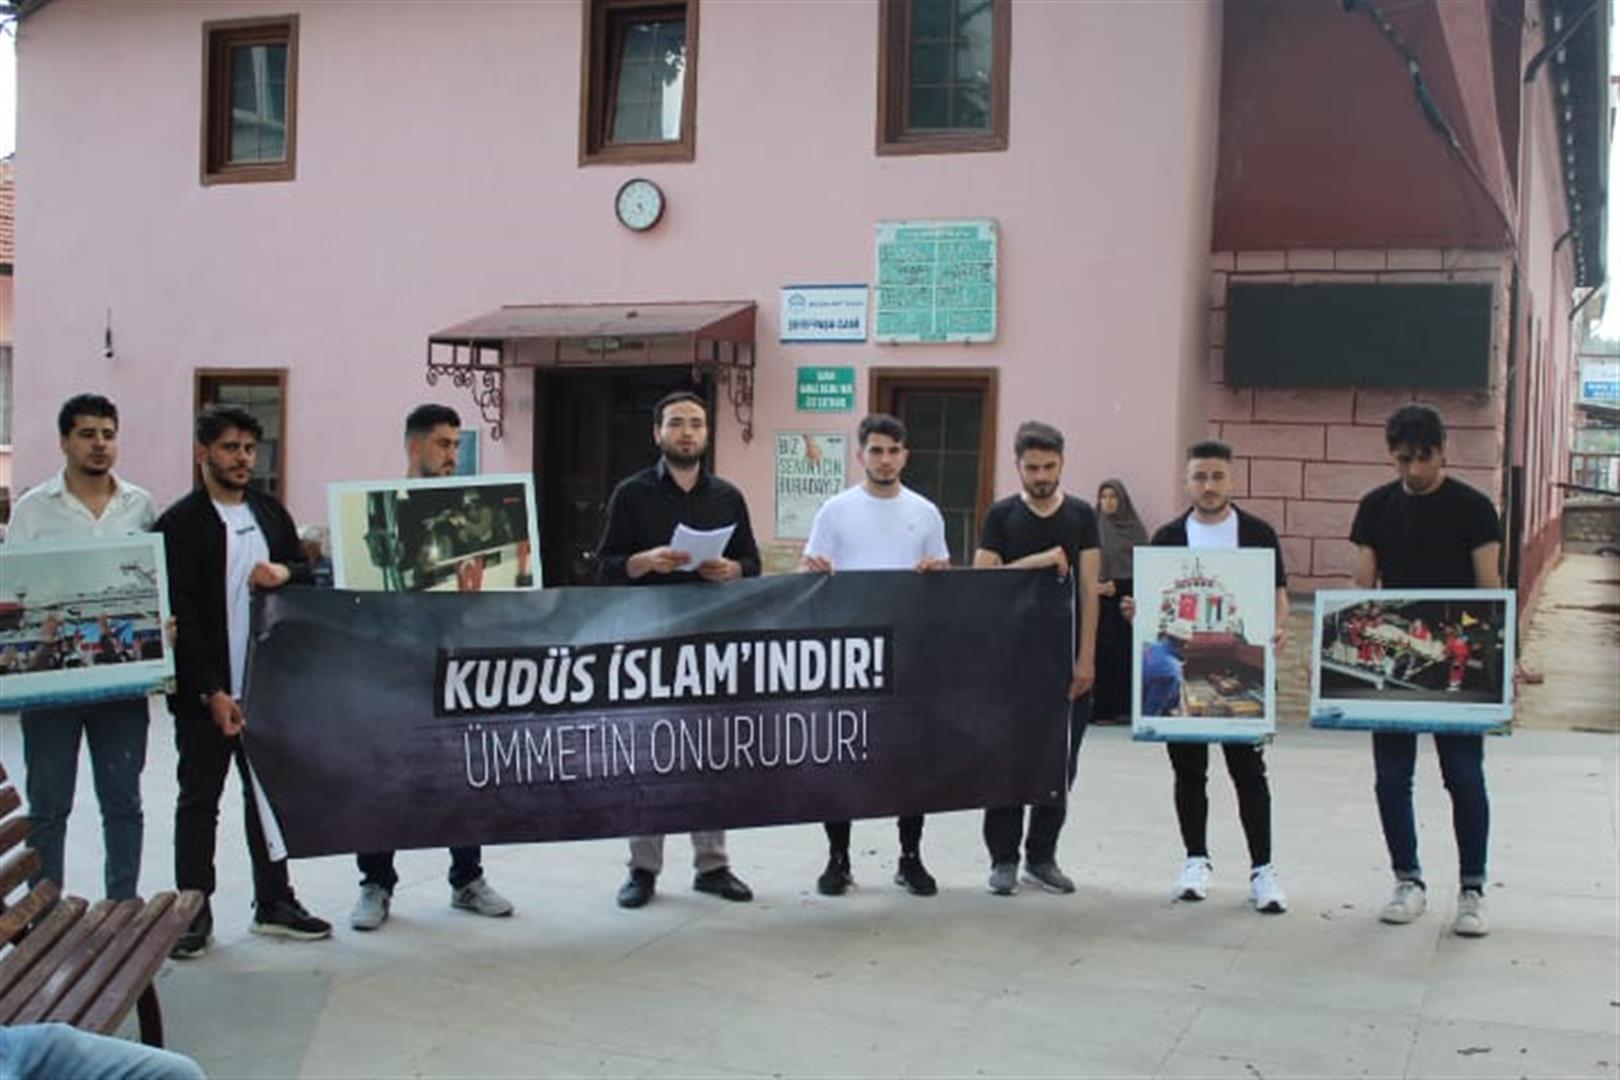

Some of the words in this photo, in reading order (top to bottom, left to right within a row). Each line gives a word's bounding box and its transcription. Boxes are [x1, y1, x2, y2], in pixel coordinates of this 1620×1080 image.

[778, 437, 799, 455] BZ
[443, 648, 597, 711] KUDÜS
[608, 636, 885, 702] İSLAM'INDIR!
[463, 717, 637, 789] ÜMMETİN
[650, 709, 869, 774] ONURUDUR!
